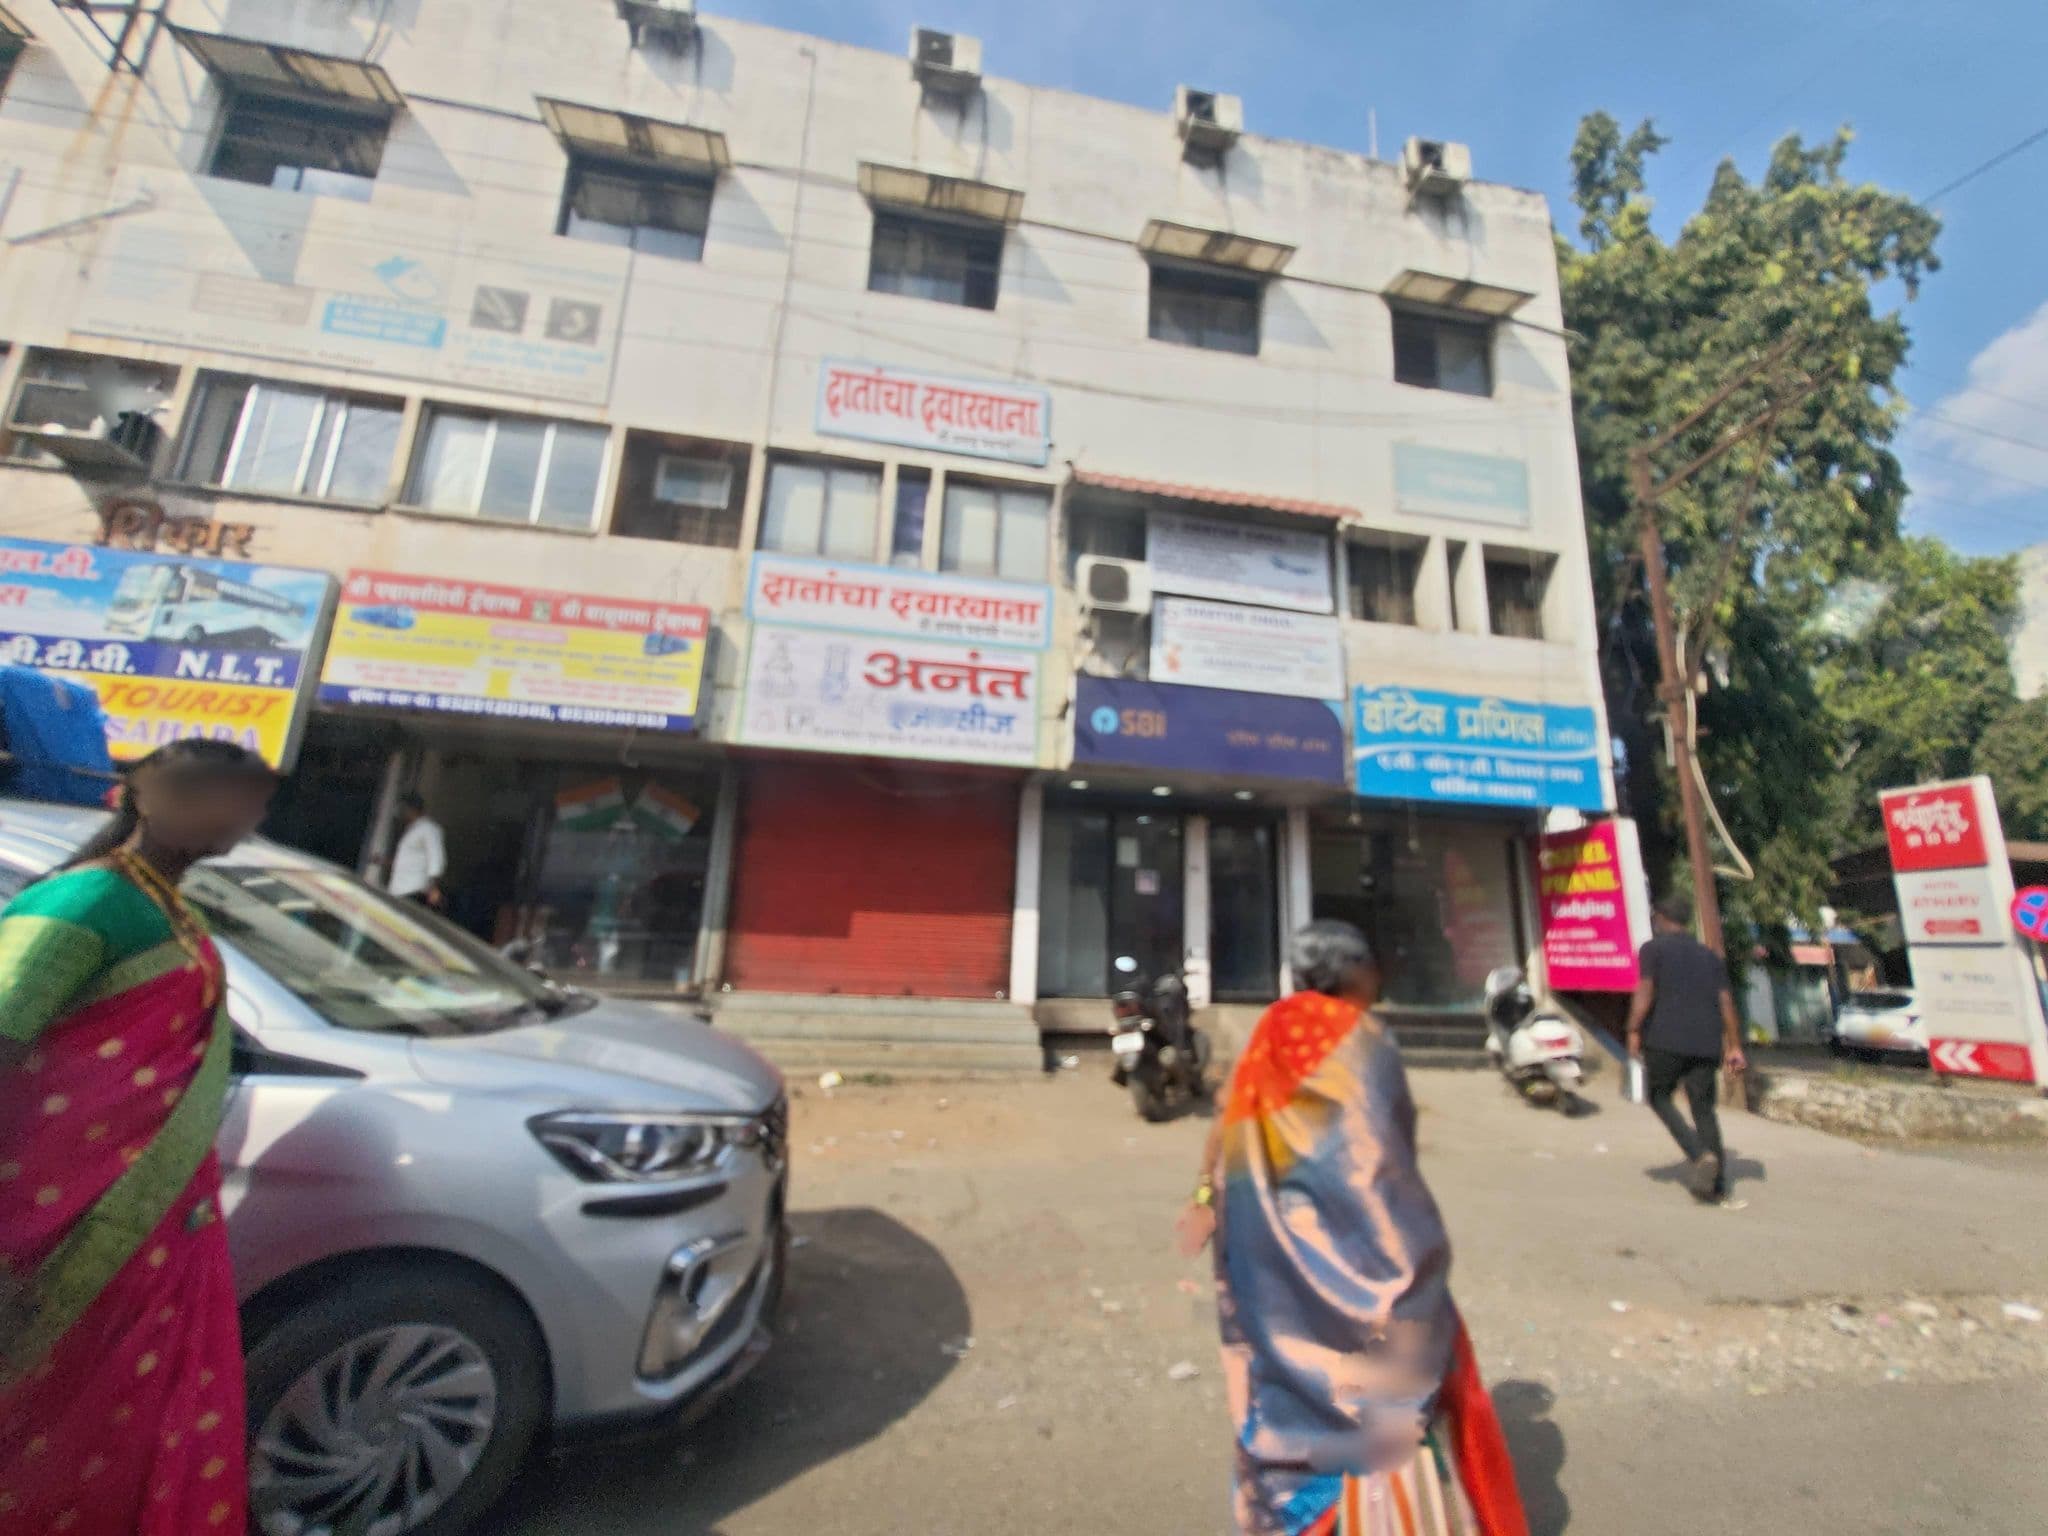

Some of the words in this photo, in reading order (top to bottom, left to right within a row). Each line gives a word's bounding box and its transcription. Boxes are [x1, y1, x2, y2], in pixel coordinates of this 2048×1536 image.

[761, 568, 882, 609] दातांचा
[175, 650, 285, 685] N.L.T.
[864, 650, 1030, 699] अनंत
[101, 682, 282, 719] TOURIST
[1361, 692, 1446, 735] हॉटेल
[1120, 708, 1167, 737] SBI
